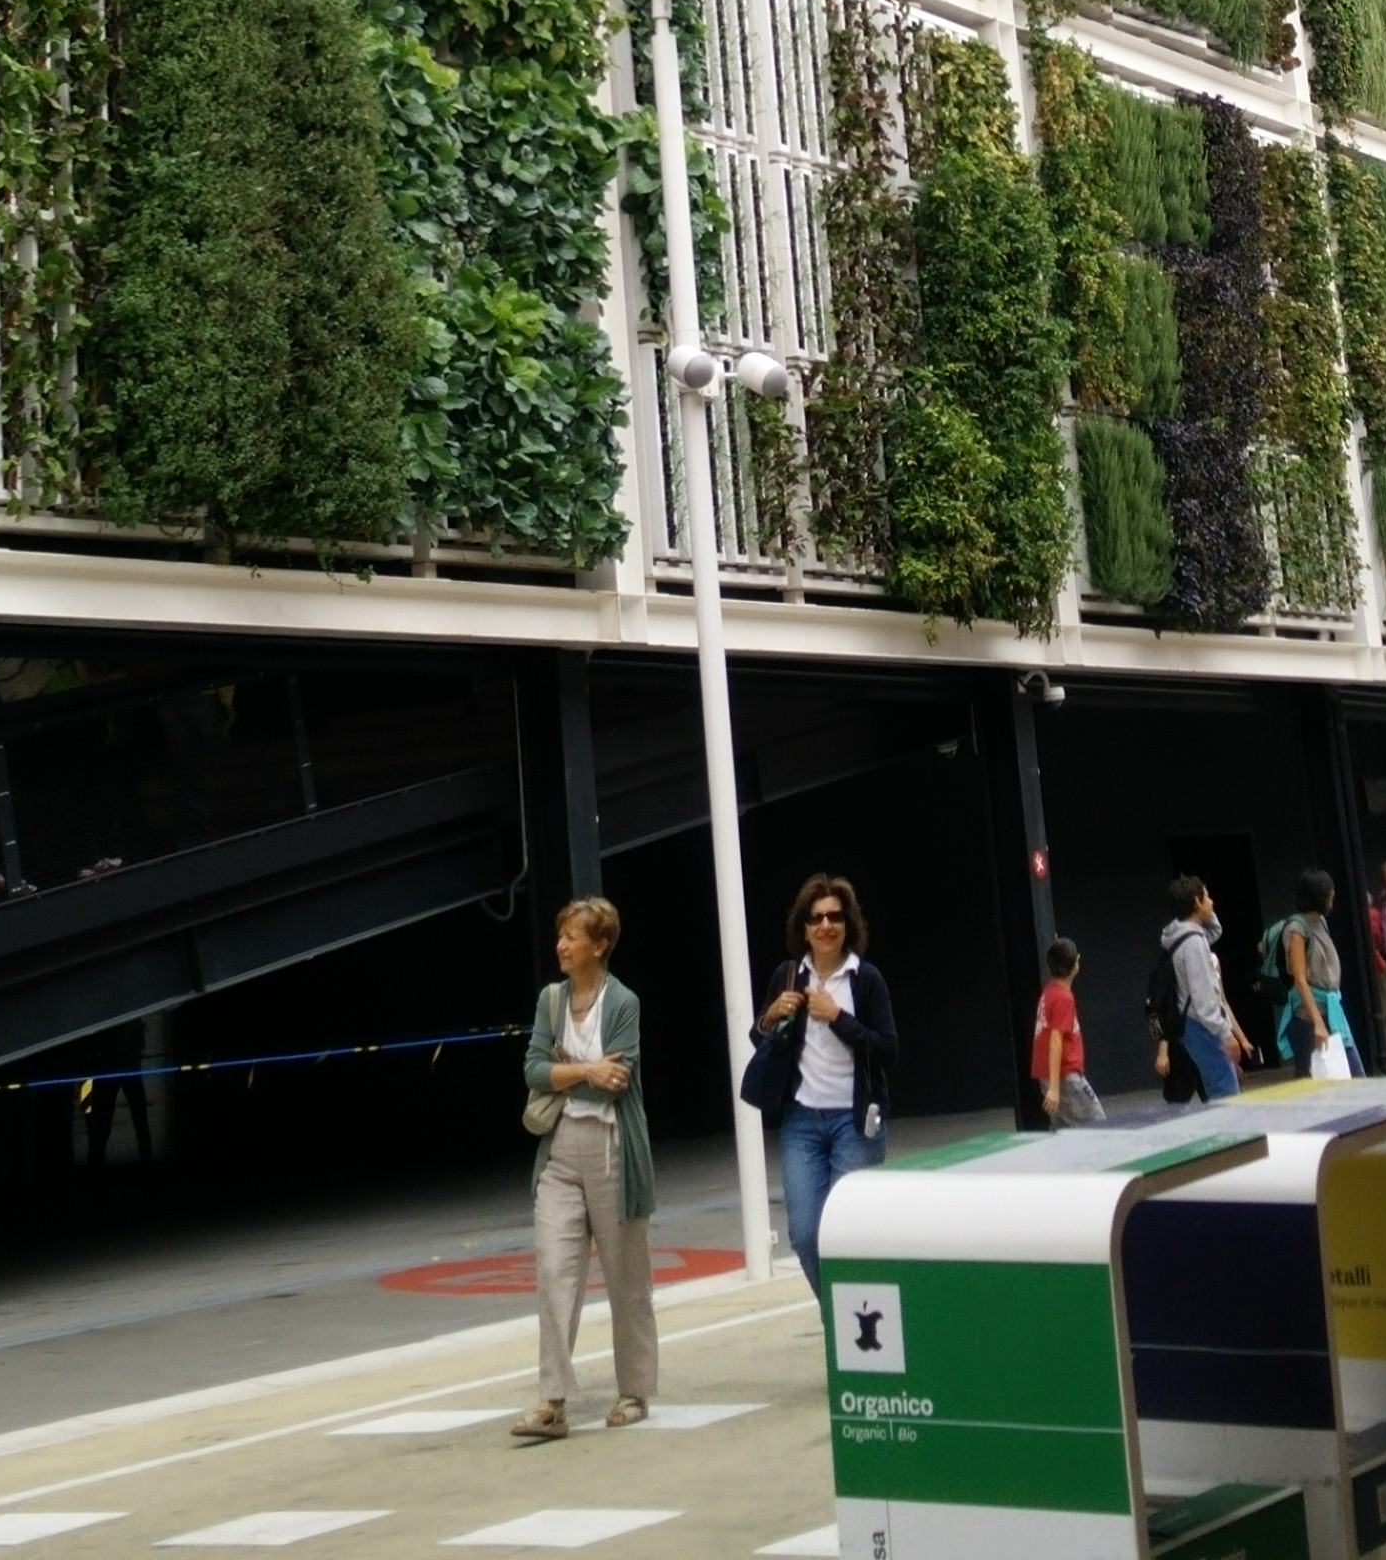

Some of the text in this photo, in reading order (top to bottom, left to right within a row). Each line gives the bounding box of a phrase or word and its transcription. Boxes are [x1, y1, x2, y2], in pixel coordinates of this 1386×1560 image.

[841, 1391, 934, 1420] Organico
[842, 1424, 917, 1443] Organic Bio
